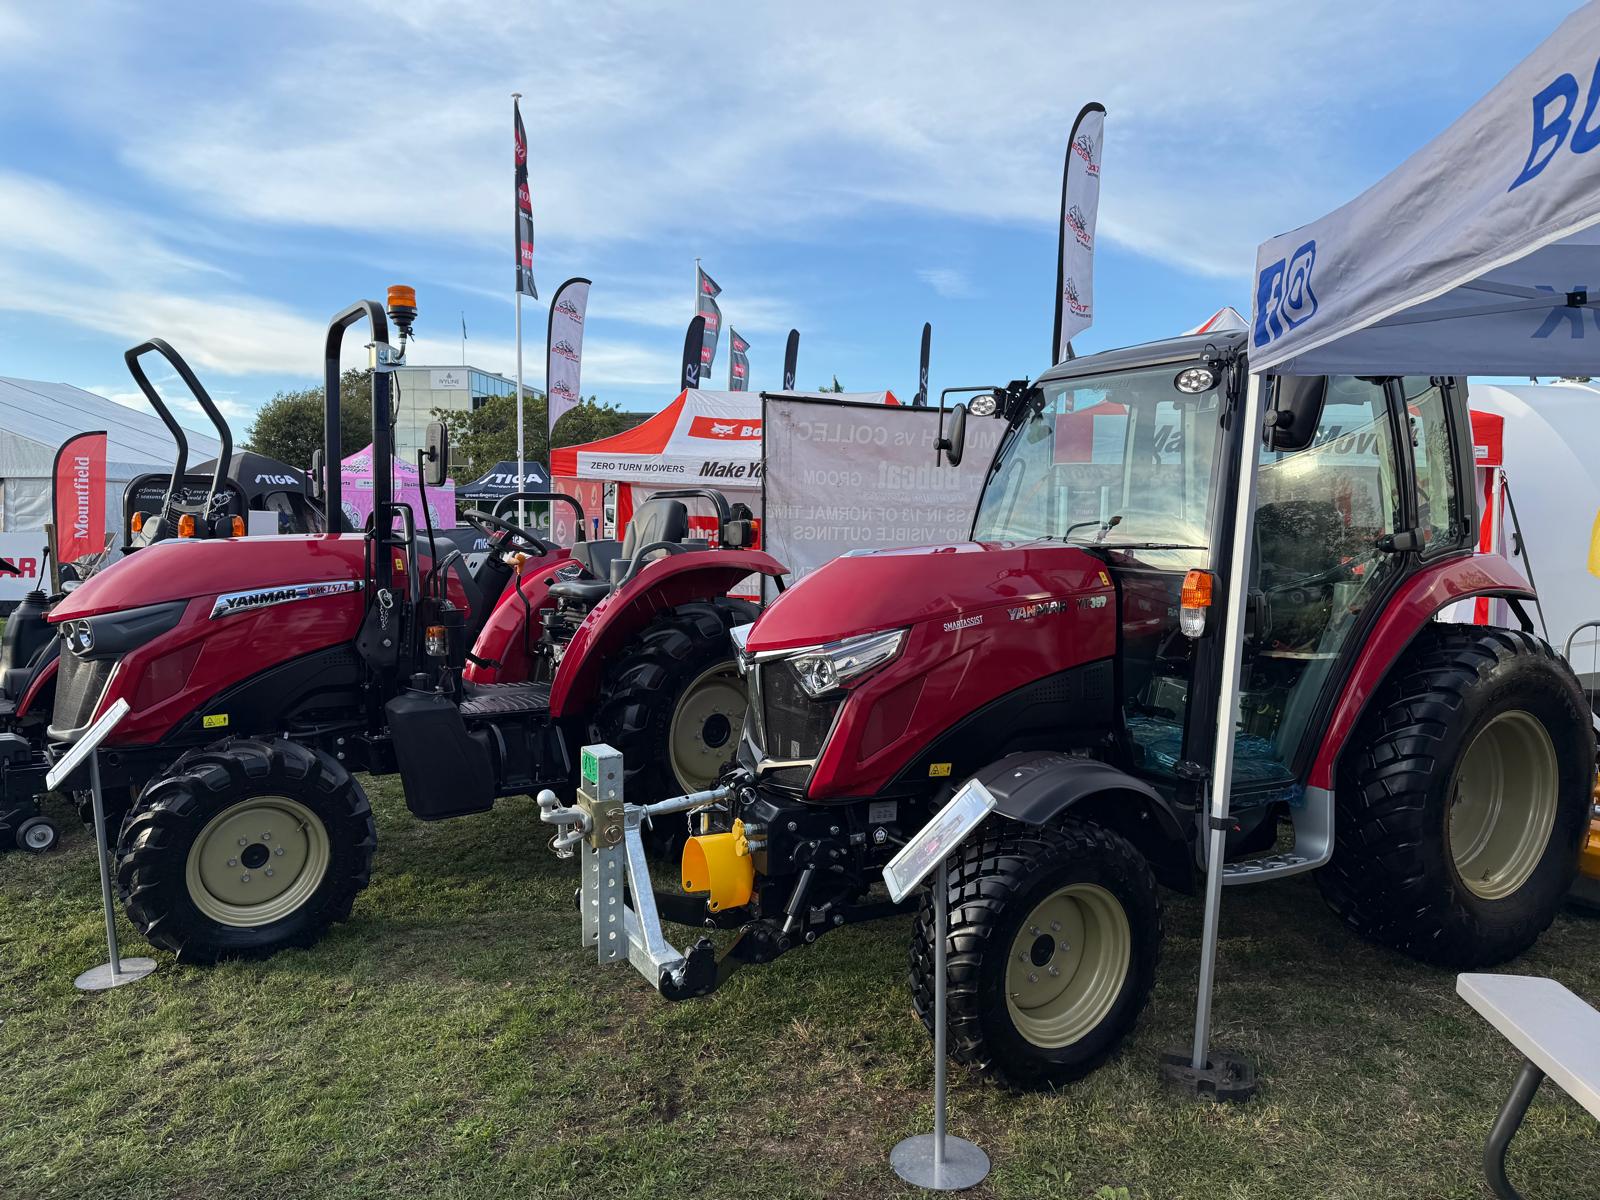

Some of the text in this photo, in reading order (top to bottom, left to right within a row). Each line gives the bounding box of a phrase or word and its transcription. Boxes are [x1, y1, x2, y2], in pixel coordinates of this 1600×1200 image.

[590, 461, 685, 473] ZERO TURN MOWERS
[698, 461, 745, 478] Make
[254, 473, 300, 485] STIGA
[73, 456, 90, 539] Mountfield
[225, 589, 298, 609] YANMAR
[943, 614, 984, 632] SMARTASSIST
[1007, 601, 1068, 621] YANMAR
